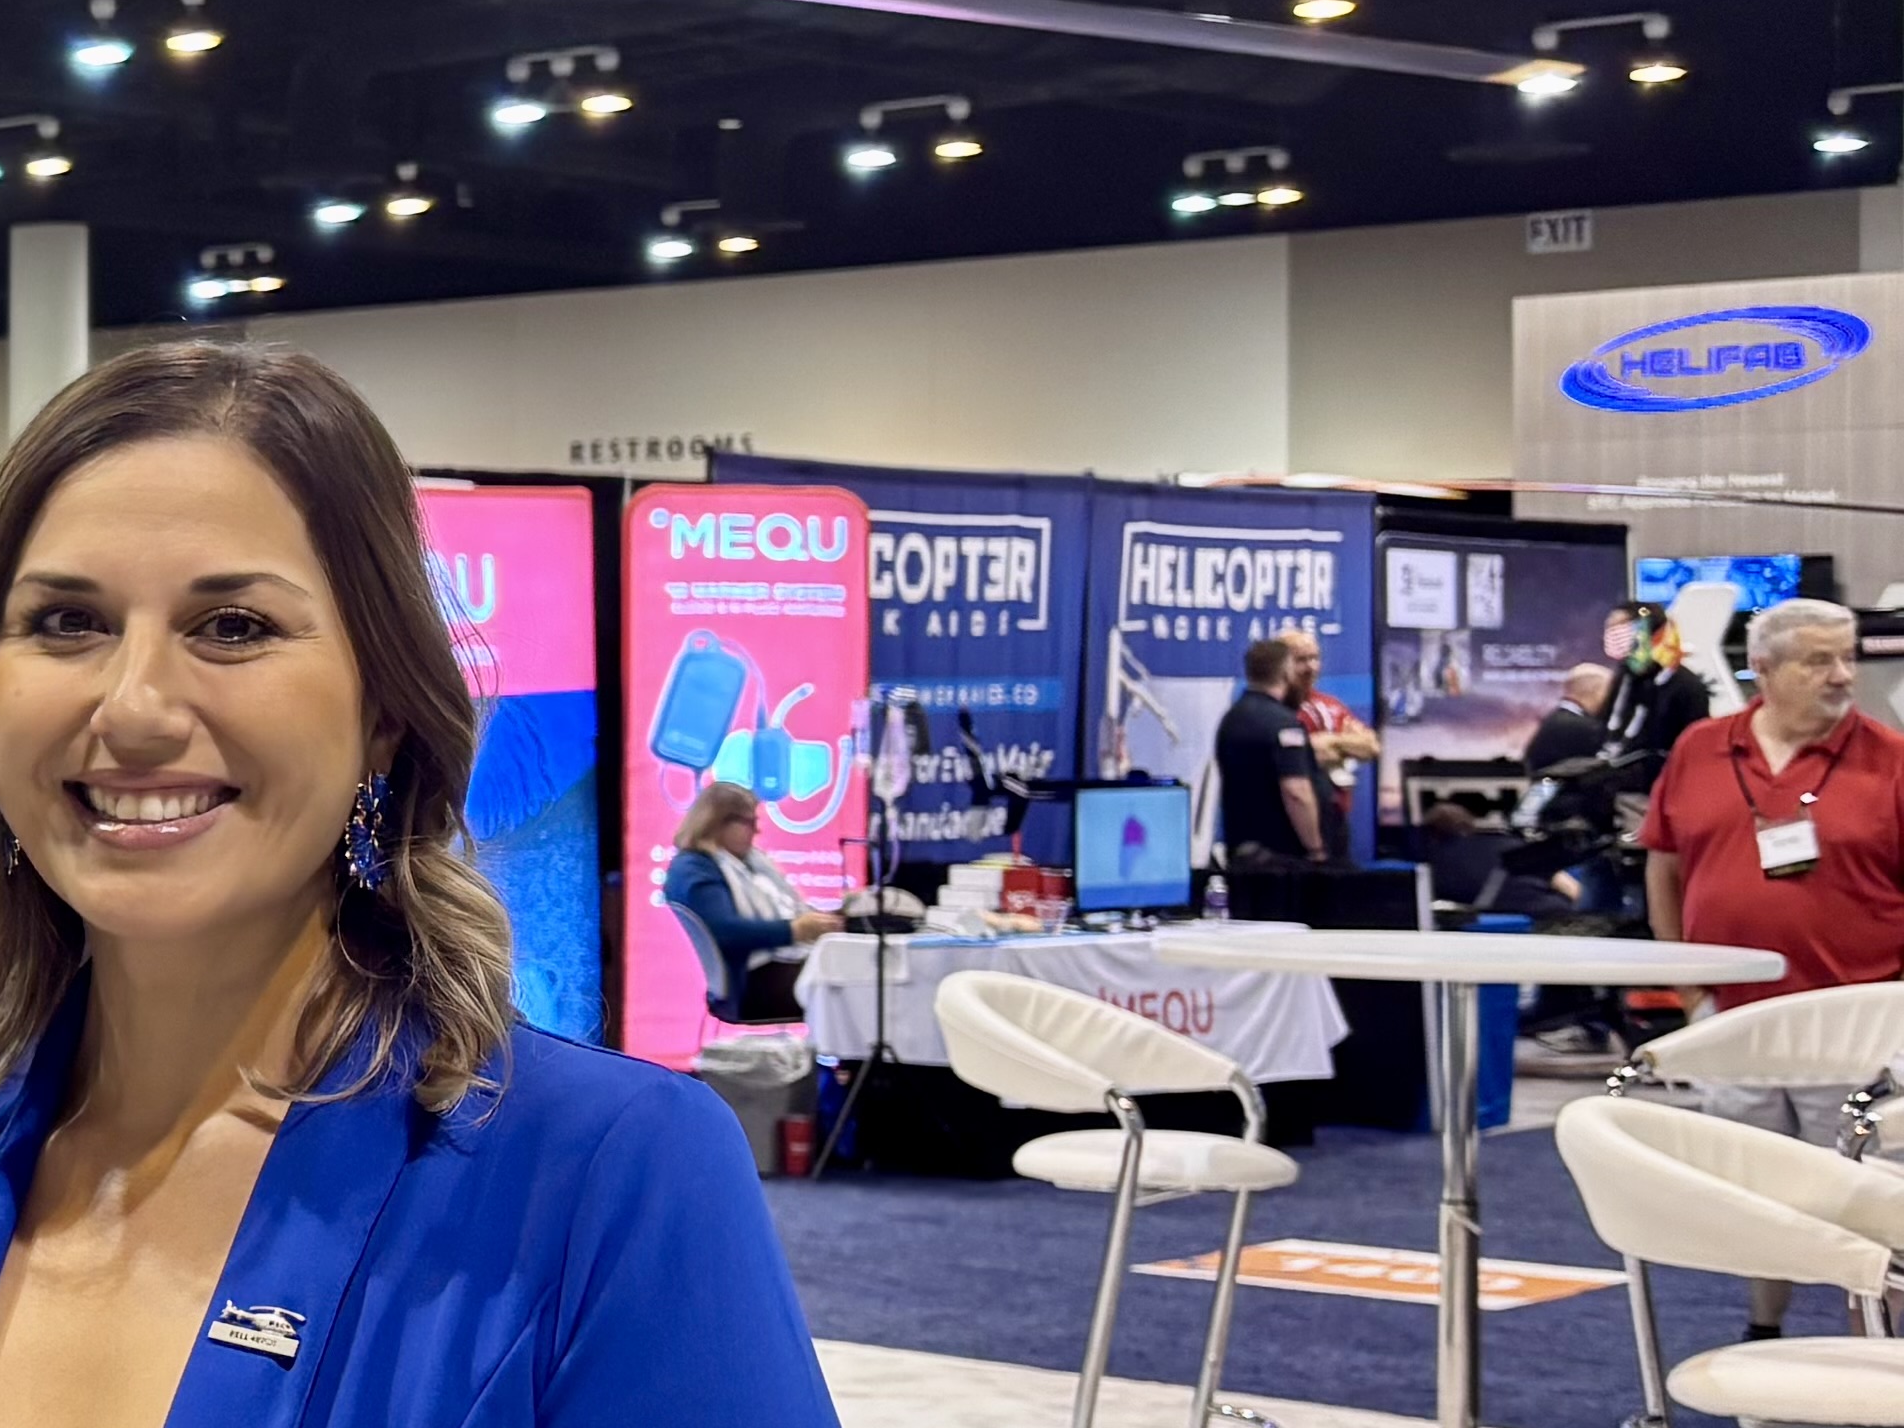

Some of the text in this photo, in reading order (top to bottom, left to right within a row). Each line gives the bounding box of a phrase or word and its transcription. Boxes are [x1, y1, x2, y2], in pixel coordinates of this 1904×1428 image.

[1530, 216, 1586, 245] EXIT
[1620, 341, 1806, 379] HELIFAB
[570, 432, 754, 463] RESTROOMS
[670, 512, 848, 562] MEQU
[869, 532, 1035, 604] COPTER
